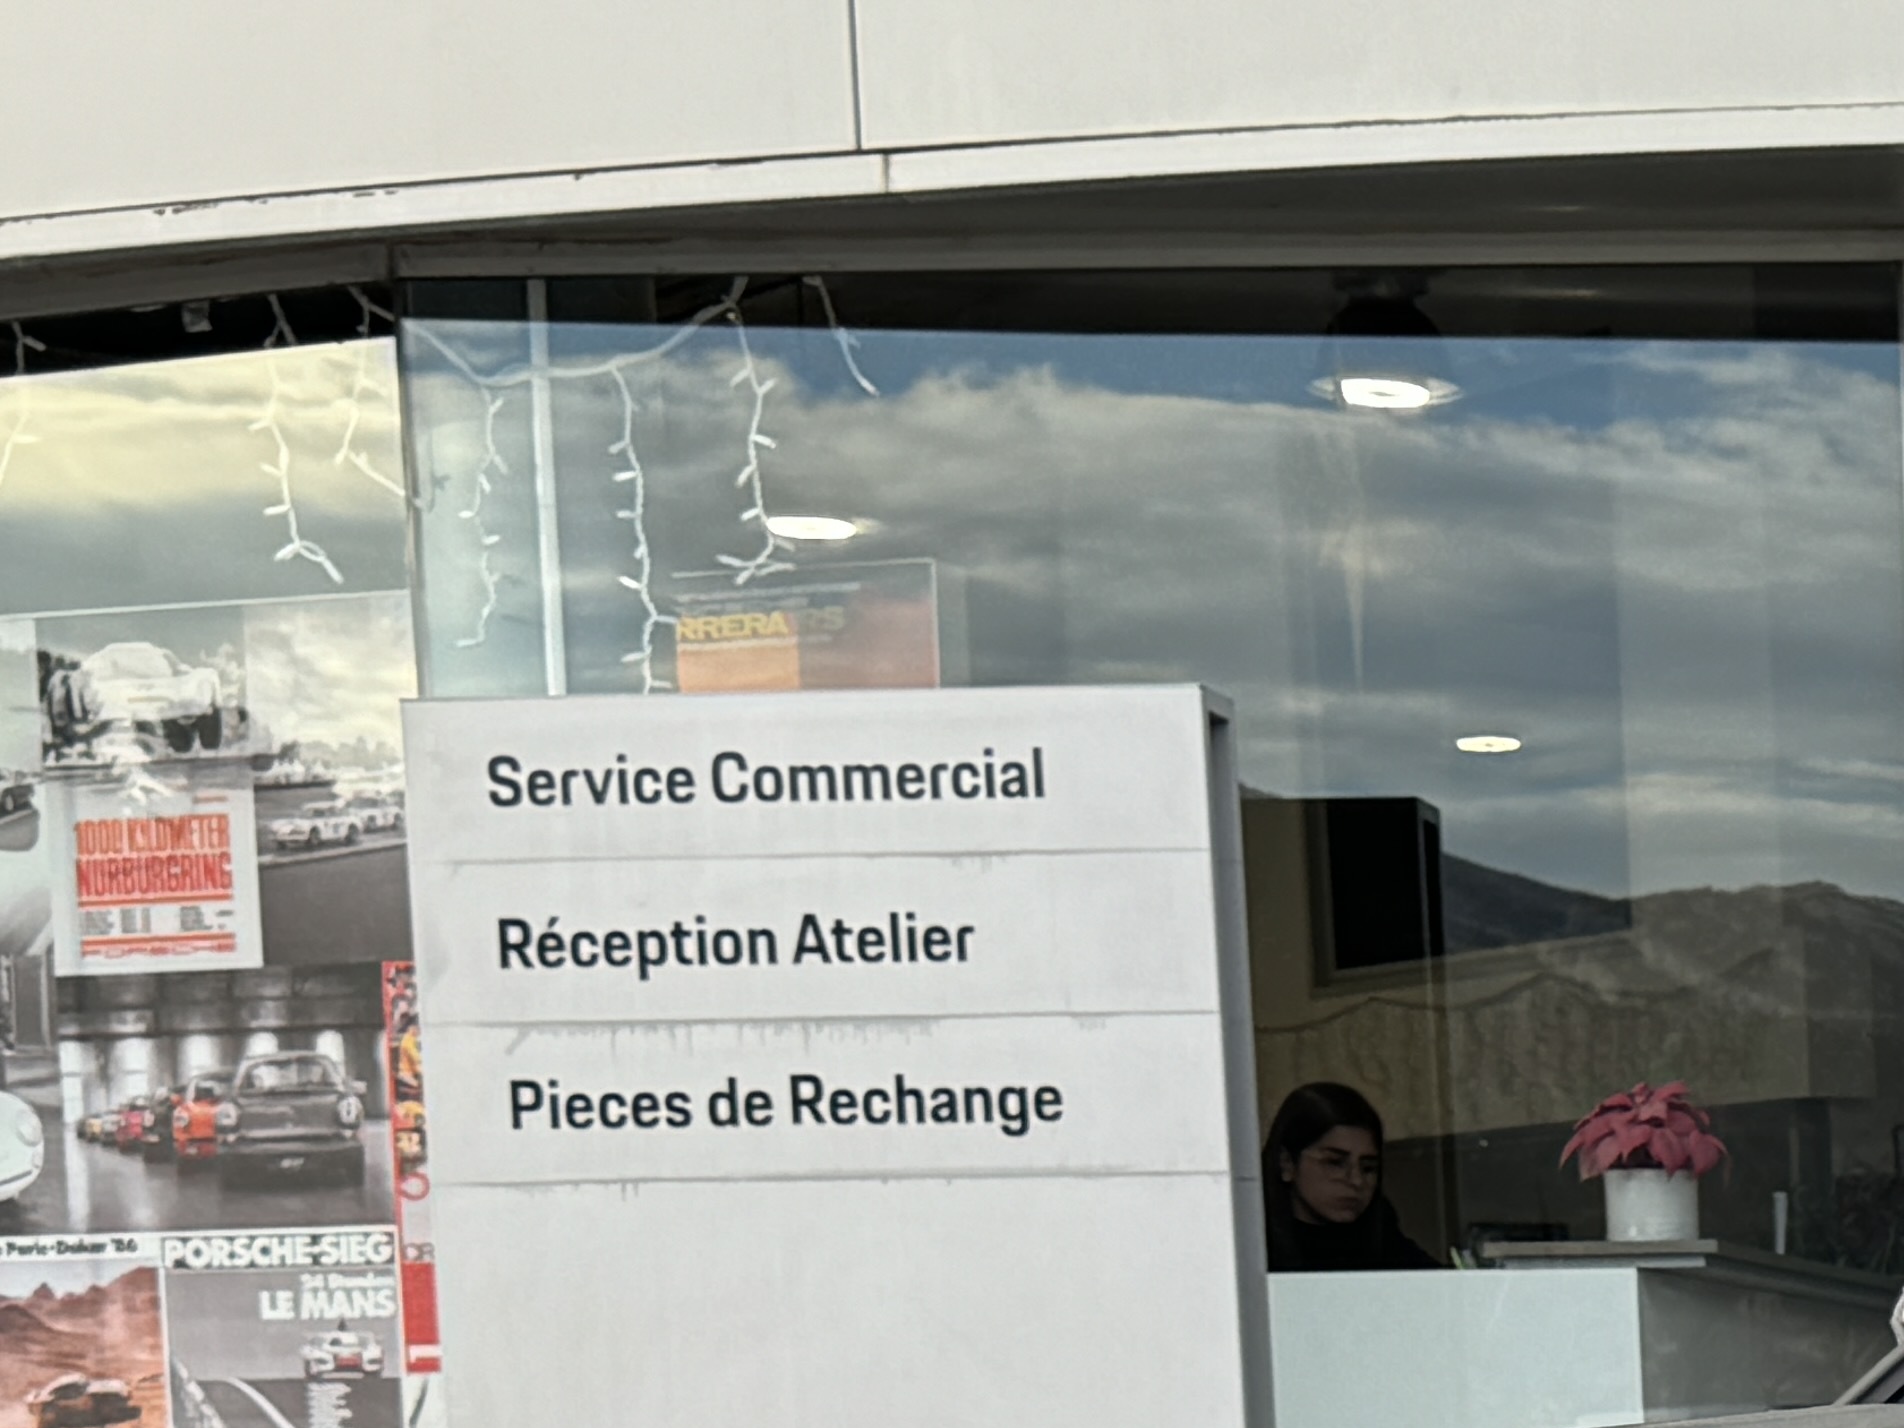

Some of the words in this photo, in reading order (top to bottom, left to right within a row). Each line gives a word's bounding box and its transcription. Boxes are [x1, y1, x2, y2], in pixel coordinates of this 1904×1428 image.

[487, 753, 696, 808] Service
[710, 746, 1045, 804] Commercial
[497, 915, 778, 982] Réception
[792, 911, 975, 965] Atelier
[509, 1078, 693, 1131] Pieces
[707, 1075, 774, 1128] de
[789, 1072, 1063, 1138] Rechange
[164, 1233, 392, 1269] PORSCHE-SIEG
[260, 1290, 295, 1321] LE
[299, 1287, 397, 1320] MANS
